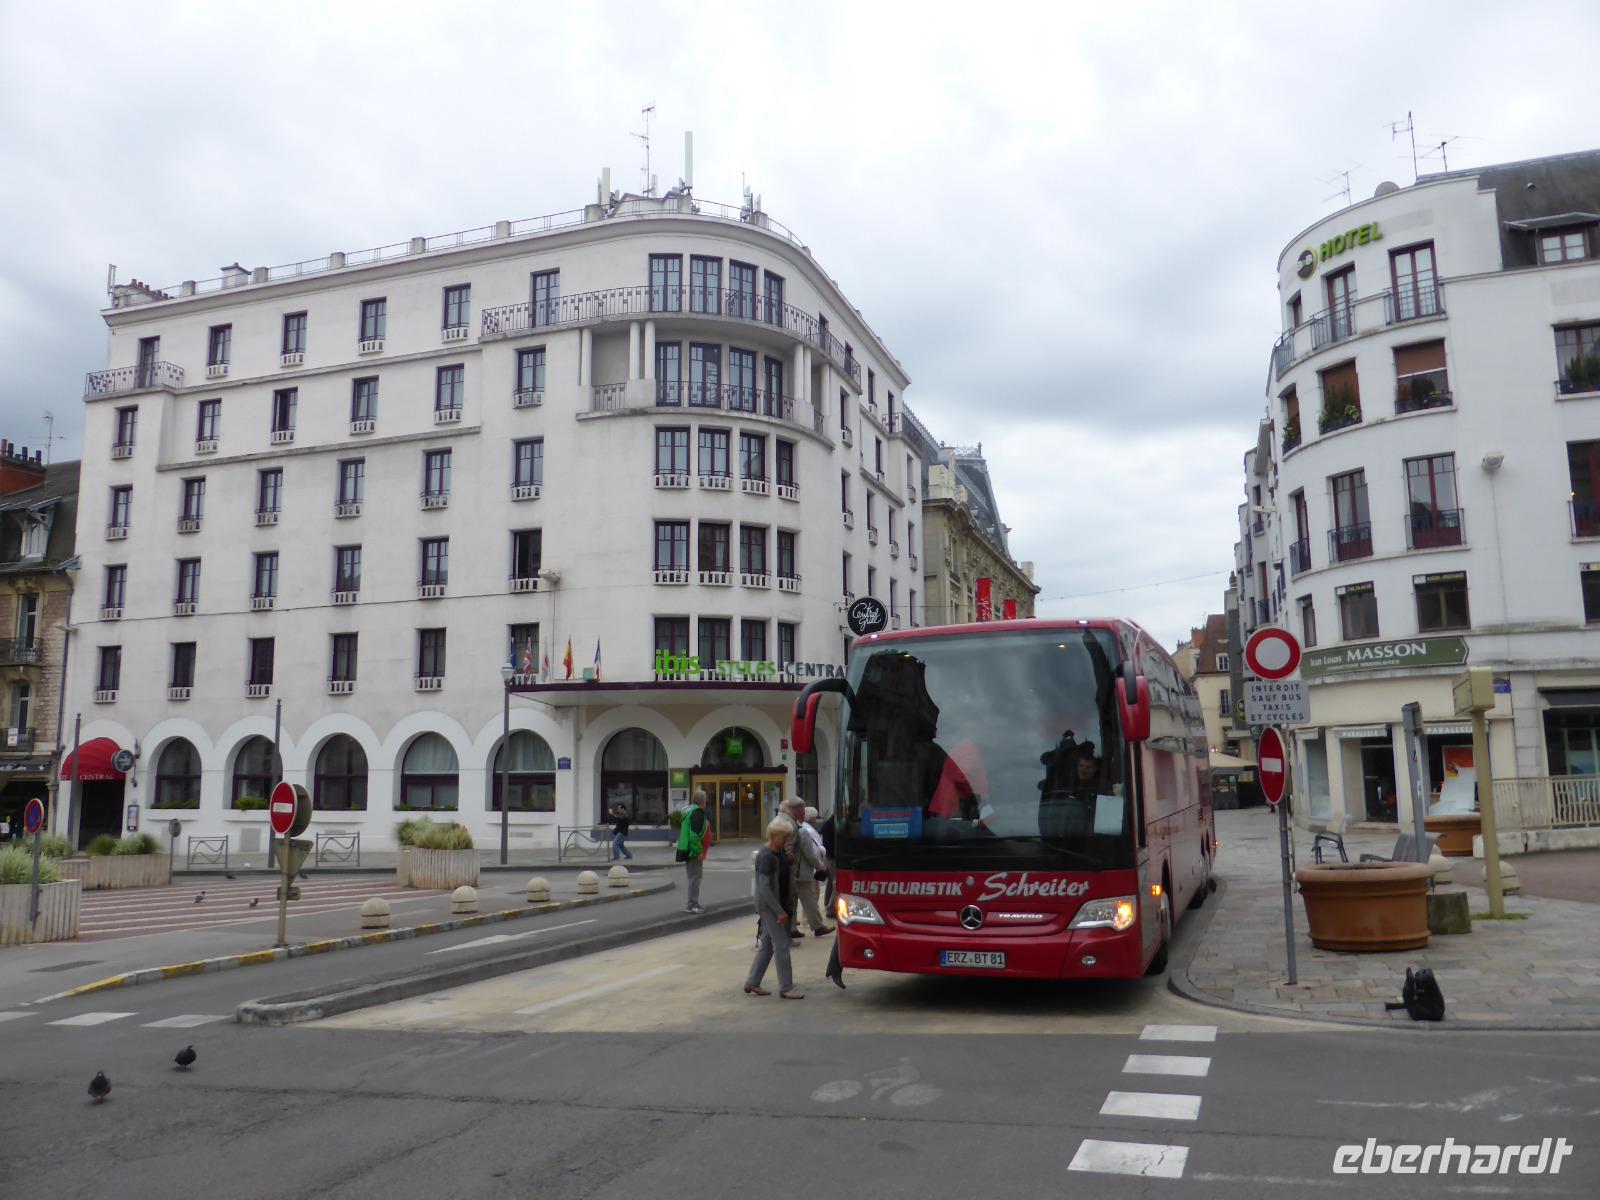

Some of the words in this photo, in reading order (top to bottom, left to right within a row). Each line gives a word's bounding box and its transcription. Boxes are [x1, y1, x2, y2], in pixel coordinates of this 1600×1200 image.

[1320, 222, 1383, 262] HOTEL
[1347, 642, 1427, 662] MASSON
[655, 649, 700, 675] ibis
[784, 661, 849, 678] CENTRA
[1251, 684, 1300, 693] INTERDIT
[1251, 694, 1277, 702] SAUF
[1281, 693, 1302, 702] BUS
[1263, 703, 1292, 711] TAXIS
[1251, 713, 1262, 721] ET
[1266, 712, 1304, 721] CYCLES
[1426, 726, 1472, 735] PARALLEL
[852, 880, 964, 896] BUSTOURISTIK
[977, 872, 1089, 901] Schreiter
[946, 952, 968, 964] ERZ
[974, 953, 989, 964] BT
[990, 954, 1004, 965] 81
